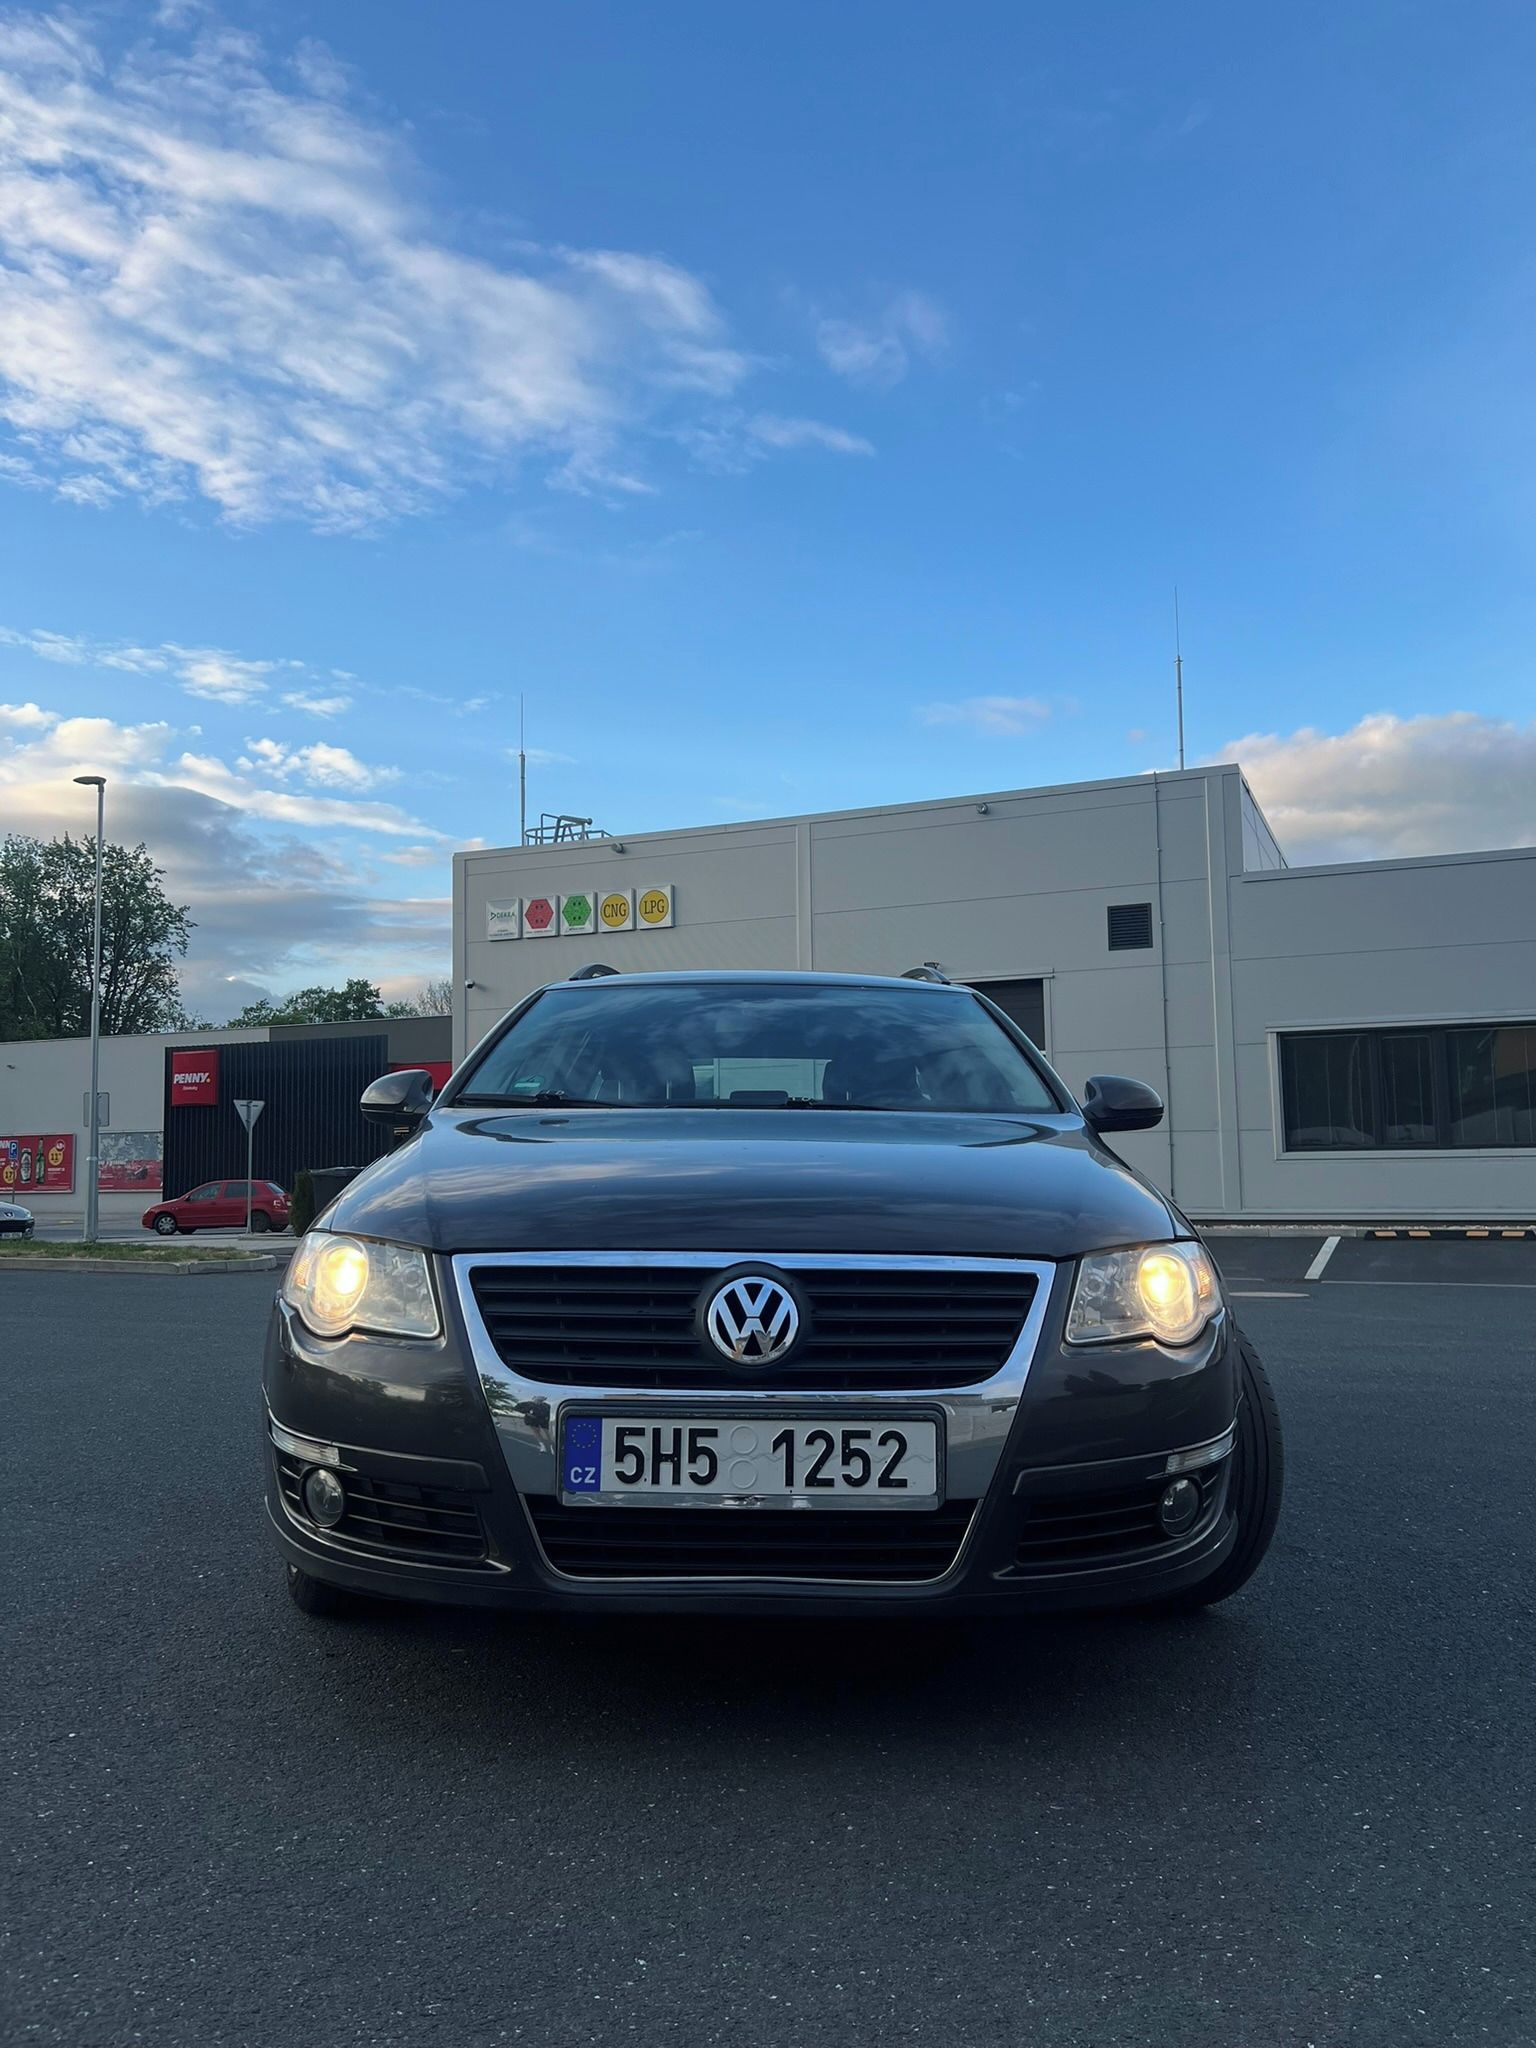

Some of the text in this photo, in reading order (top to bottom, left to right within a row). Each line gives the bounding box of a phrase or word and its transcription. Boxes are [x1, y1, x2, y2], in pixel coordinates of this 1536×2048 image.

[603, 902, 627, 918] CNG
[643, 898, 665, 915] LPG
[10, 1142, 17, 1154] P
[614, 1426, 908, 1489] 5H5 1252
[569, 1466, 597, 1485] CZ
